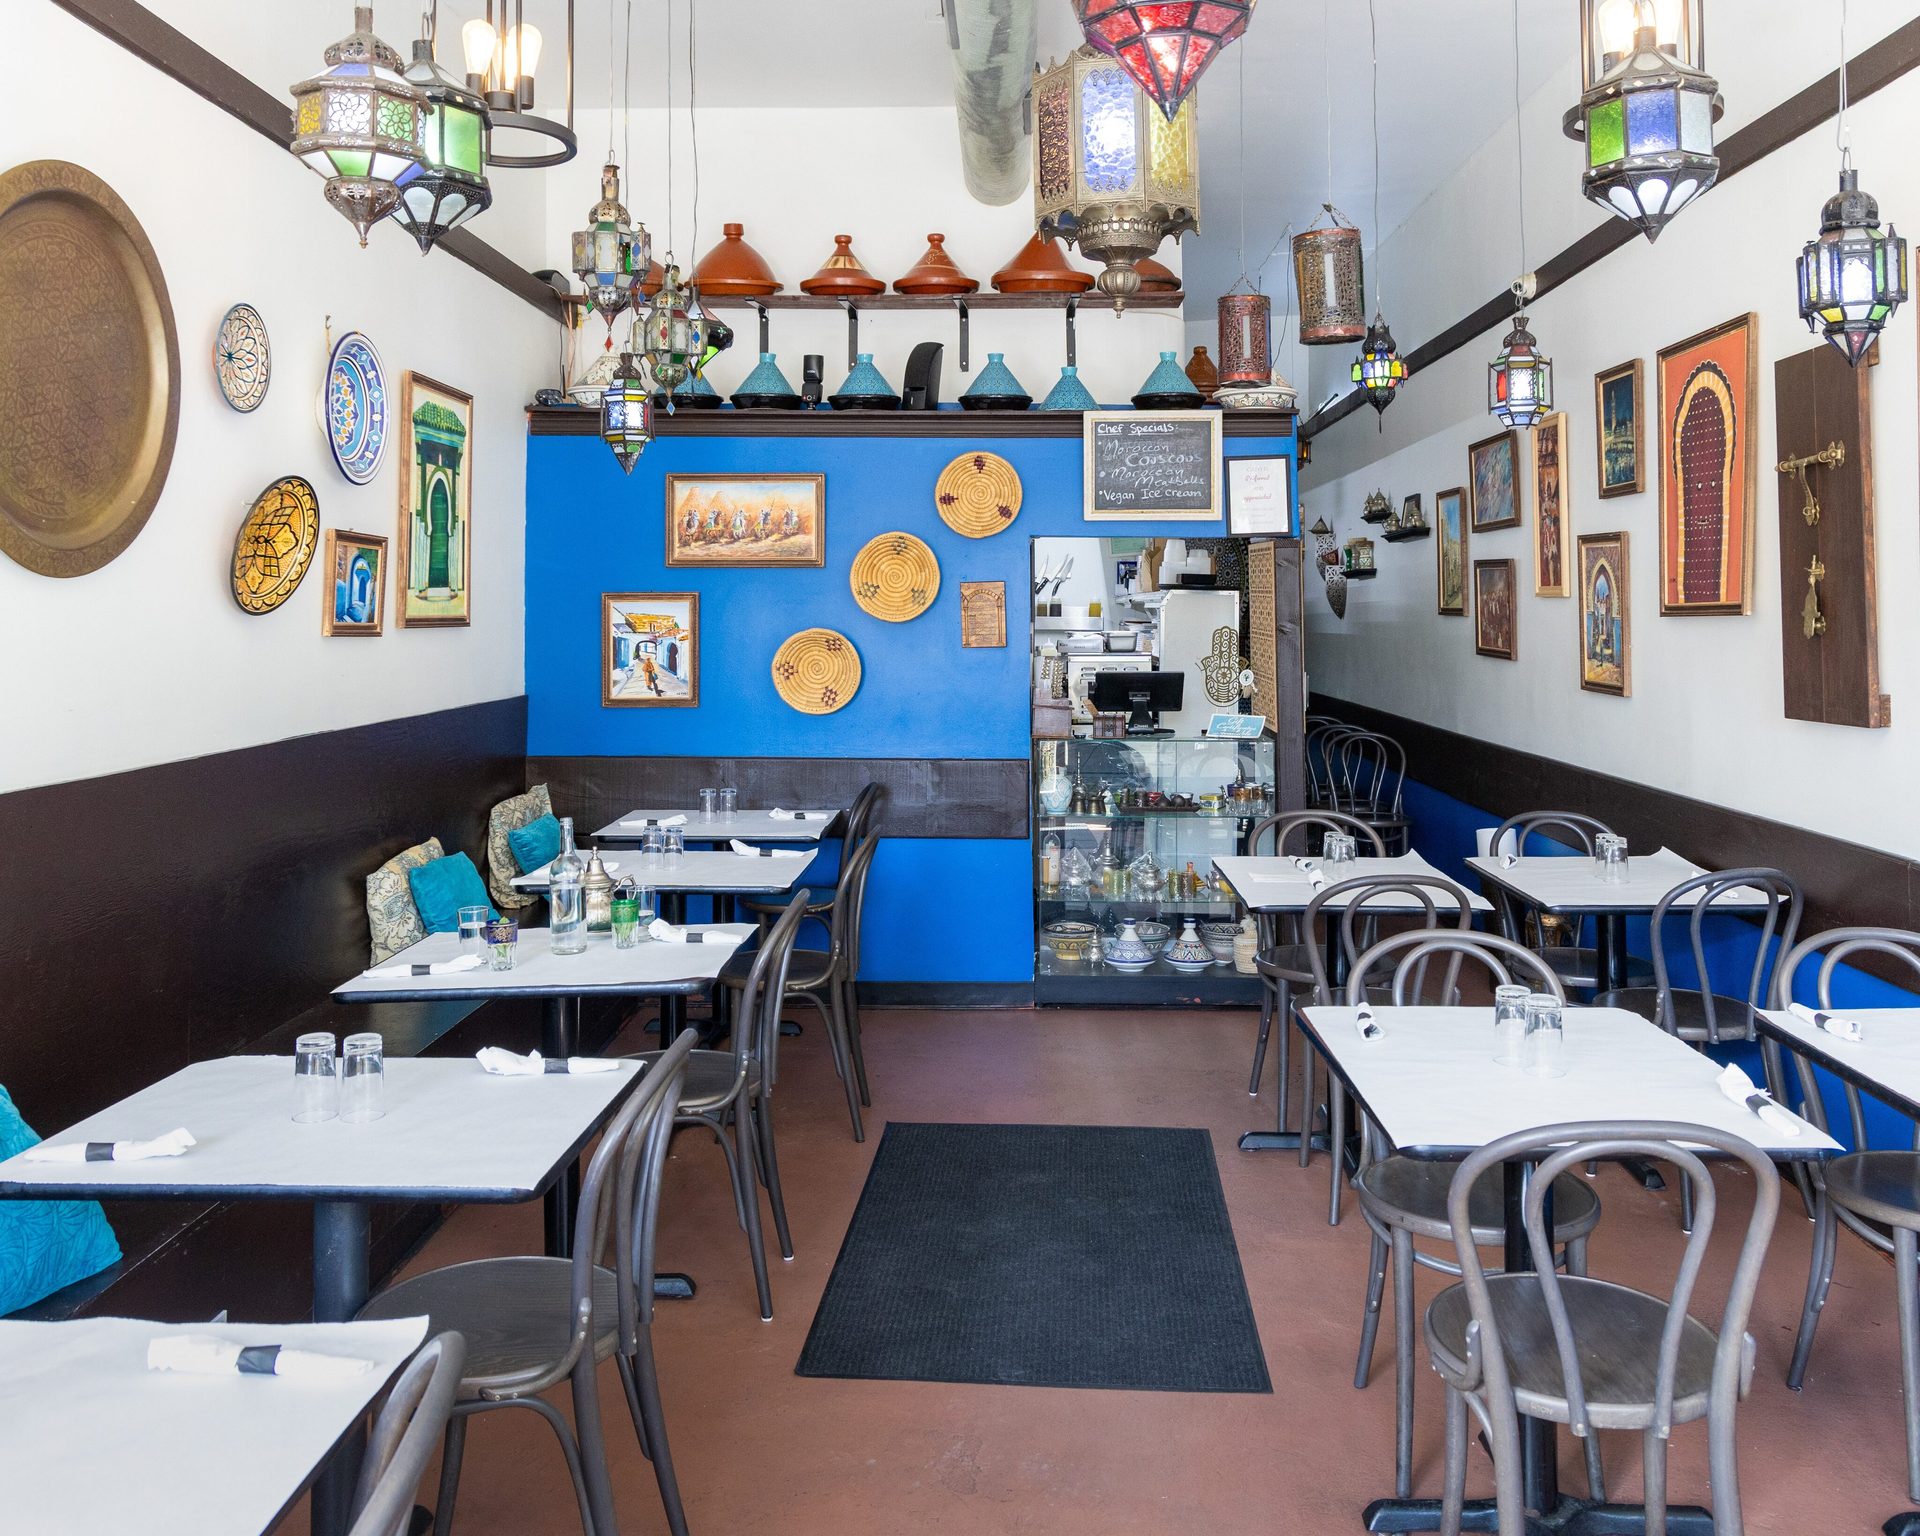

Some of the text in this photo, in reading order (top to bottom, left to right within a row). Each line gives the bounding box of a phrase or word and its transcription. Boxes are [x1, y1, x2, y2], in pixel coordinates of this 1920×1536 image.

[1097, 422, 1179, 436] Chef Specials:
[1103, 439, 1170, 459] Moroccan
[1125, 453, 1203, 467] Couscous
[1111, 466, 1184, 479] Moroccan
[1103, 489, 1135, 504] Vegan
[1140, 488, 1163, 499] Ice
